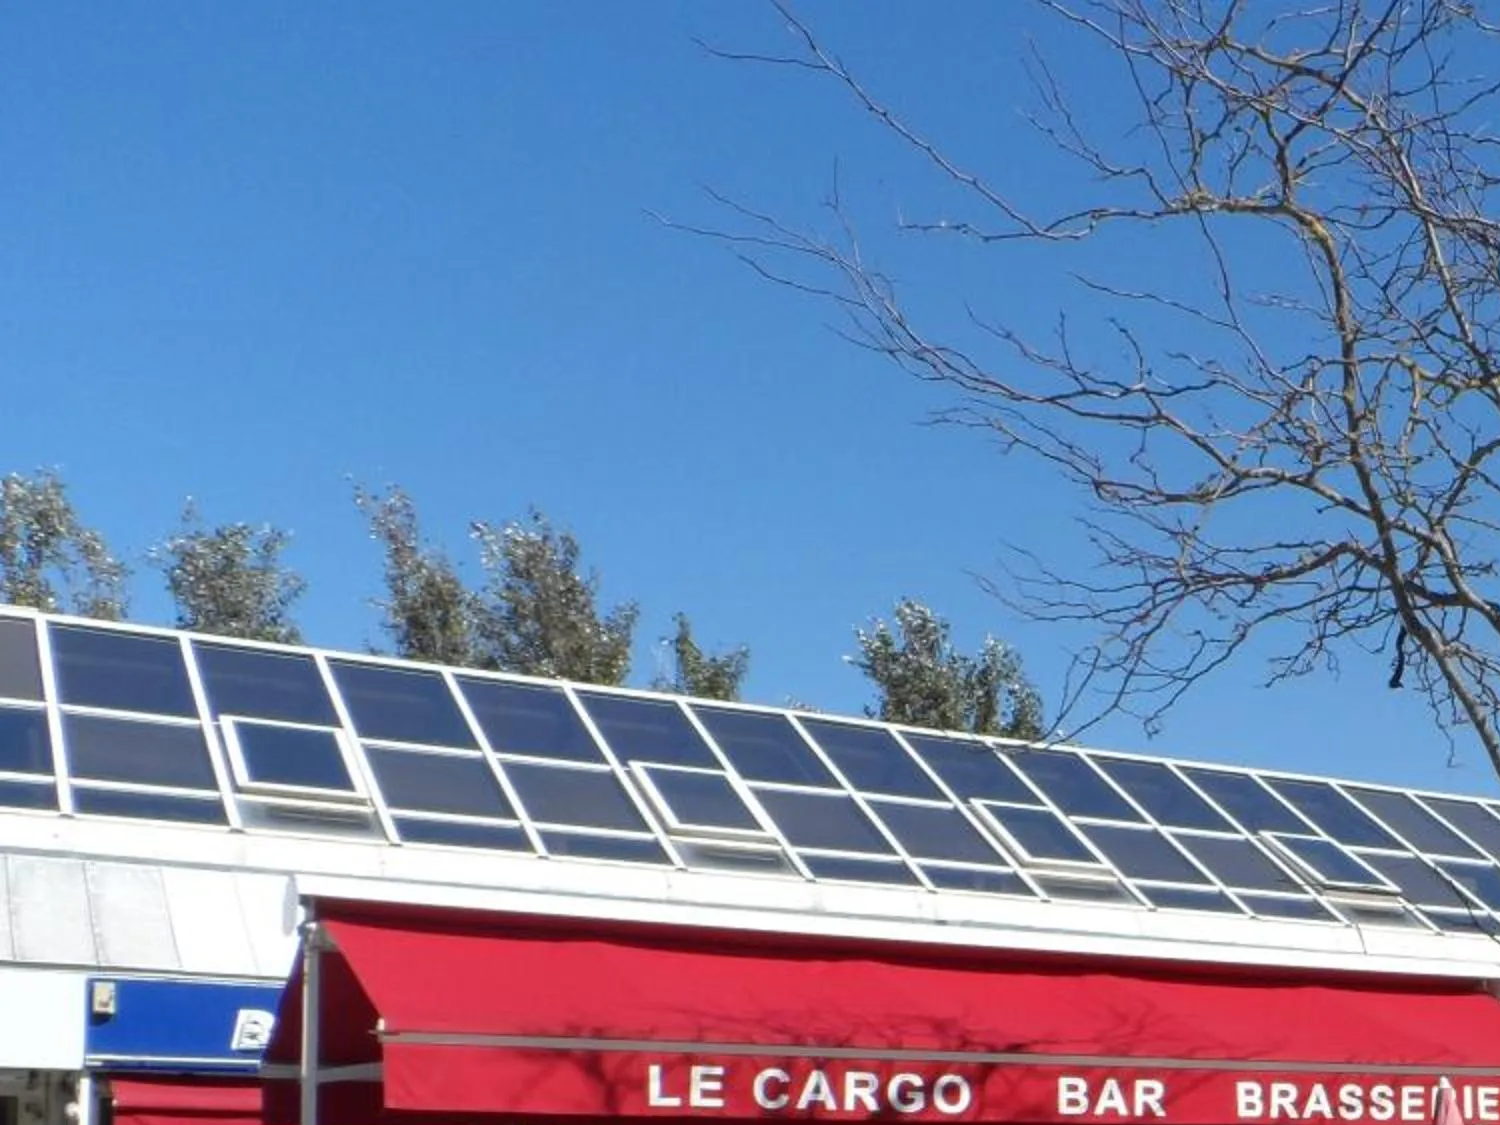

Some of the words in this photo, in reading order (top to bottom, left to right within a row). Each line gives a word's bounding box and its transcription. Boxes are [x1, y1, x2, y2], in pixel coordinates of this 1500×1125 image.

[648, 1064, 725, 1108] LE
[753, 1068, 972, 1114] CARGO
[1057, 1076, 1167, 1117] BAR
